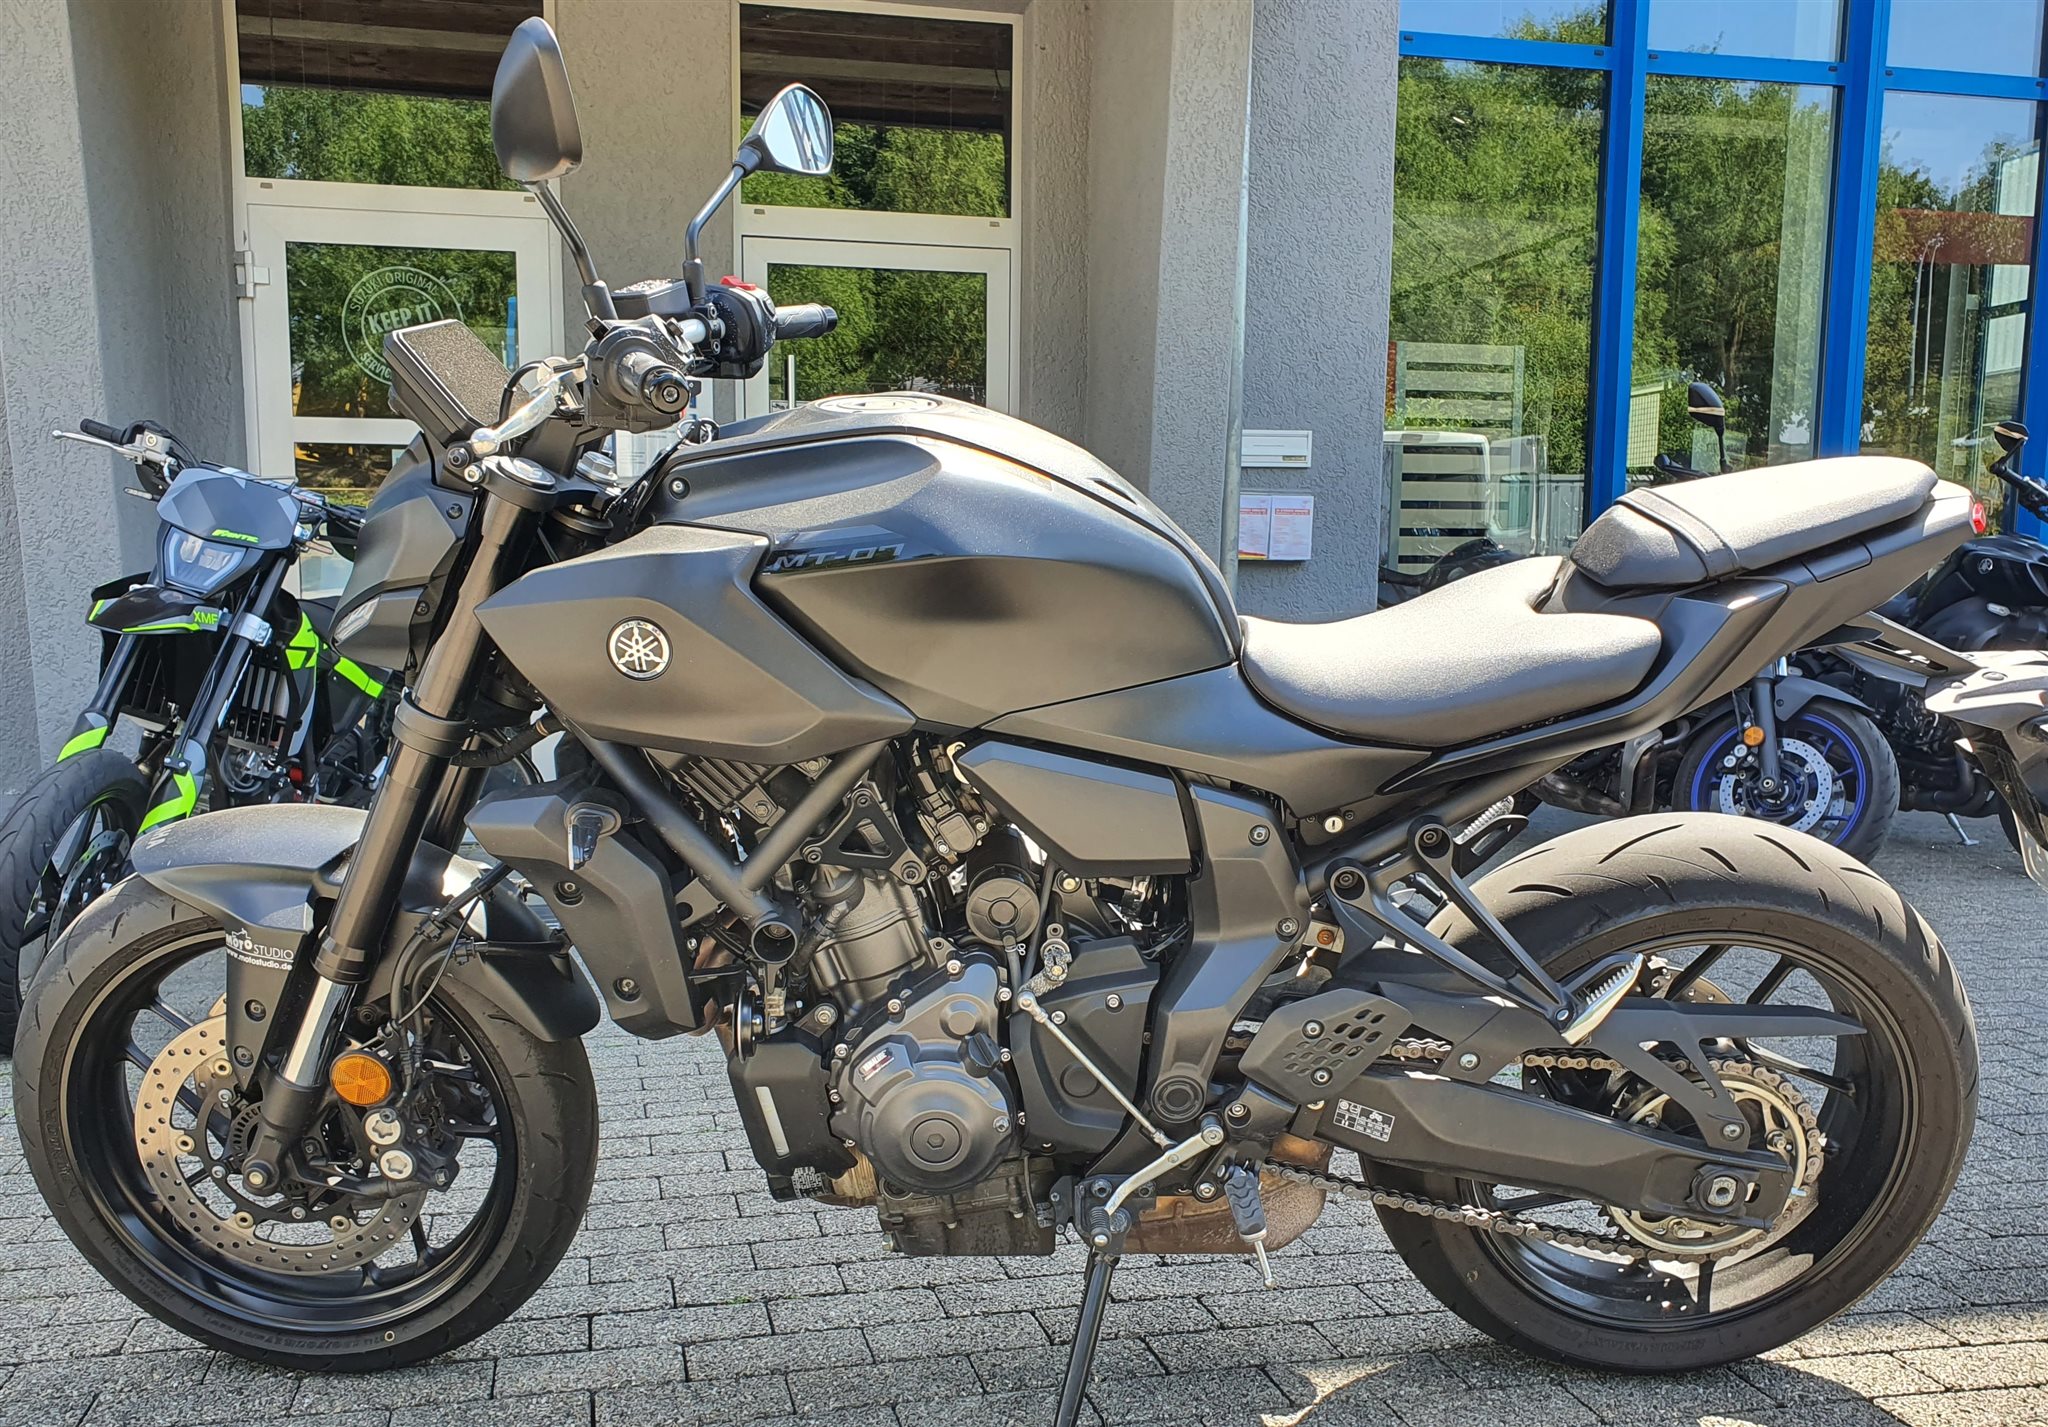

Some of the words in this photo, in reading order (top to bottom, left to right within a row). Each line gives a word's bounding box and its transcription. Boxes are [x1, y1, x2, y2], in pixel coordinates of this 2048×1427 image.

[350, 276, 384, 312] SUZUKI
[384, 272, 439, 296] ORIGINAL
[366, 307, 412, 335] KEEP
[415, 300, 433, 323] IT
[360, 352, 393, 379] SERVIC
[773, 543, 905, 571] MT-07
[226, 948, 293, 971] www.motostudio.de
[253, 943, 294, 960] STUDIO
